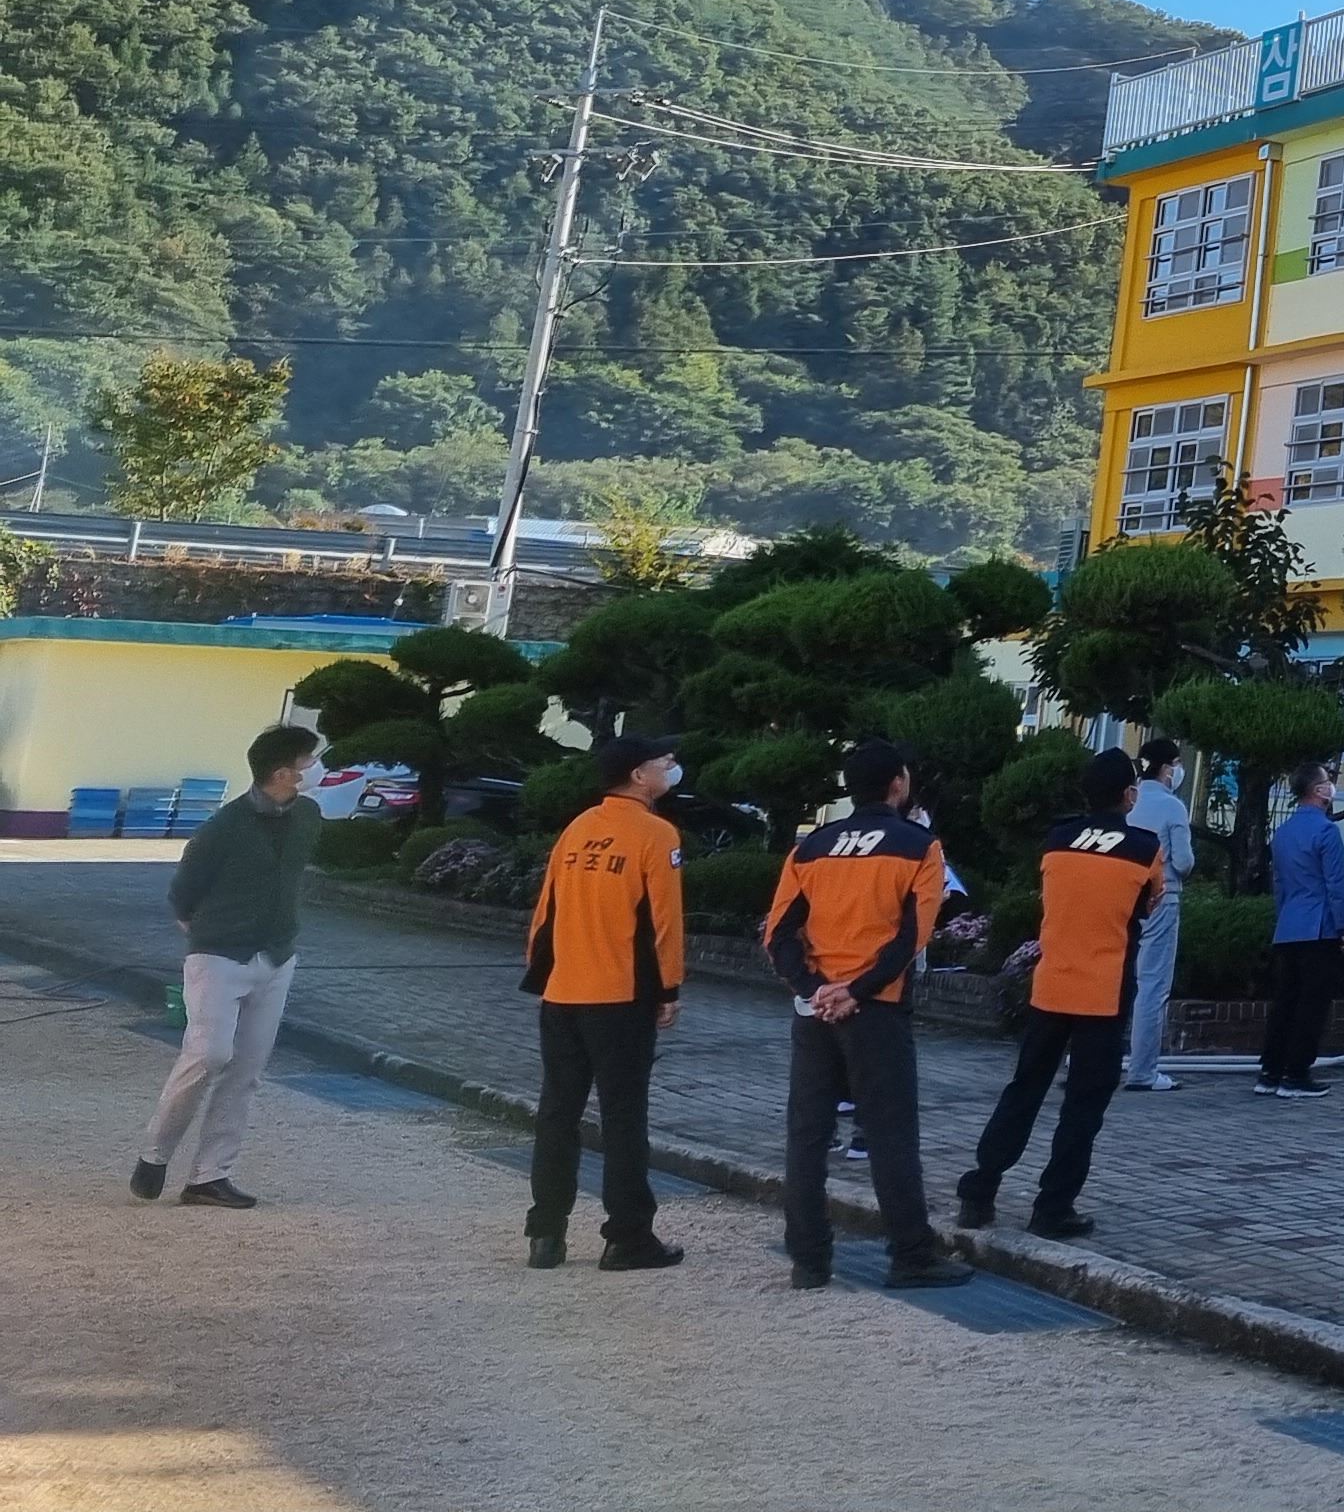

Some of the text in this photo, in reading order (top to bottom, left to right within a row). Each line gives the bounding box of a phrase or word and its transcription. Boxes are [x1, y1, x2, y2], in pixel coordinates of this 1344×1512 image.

[828, 829, 886, 857] 119
[1069, 830, 1127, 854] 119
[564, 852, 627, 875] 구조대
